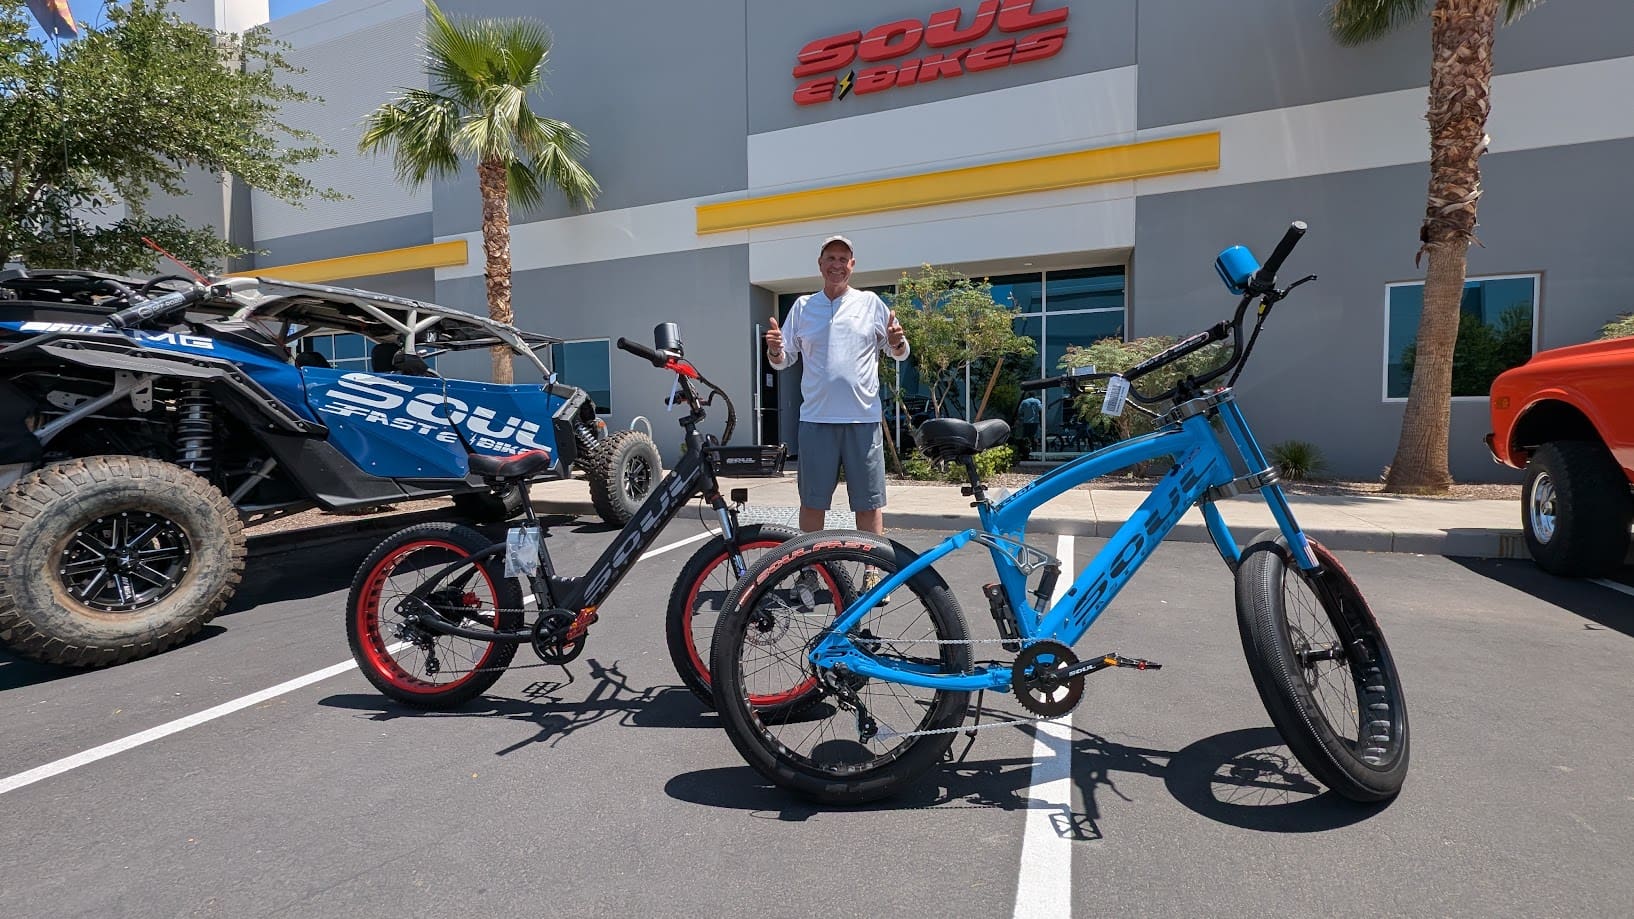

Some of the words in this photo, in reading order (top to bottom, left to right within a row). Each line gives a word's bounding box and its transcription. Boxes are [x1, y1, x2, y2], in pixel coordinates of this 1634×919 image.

[793, 0, 1069, 78] SOUL
[793, 76, 837, 106] E
[853, 27, 1069, 96] BIKES
[319, 401, 439, 435] FAST
[436, 431, 458, 443] E
[325, 372, 552, 452] SOUL
[584, 466, 700, 606] SOUL
[1072, 457, 1216, 626] SOUL
[1069, 664, 1096, 677] SOUL
